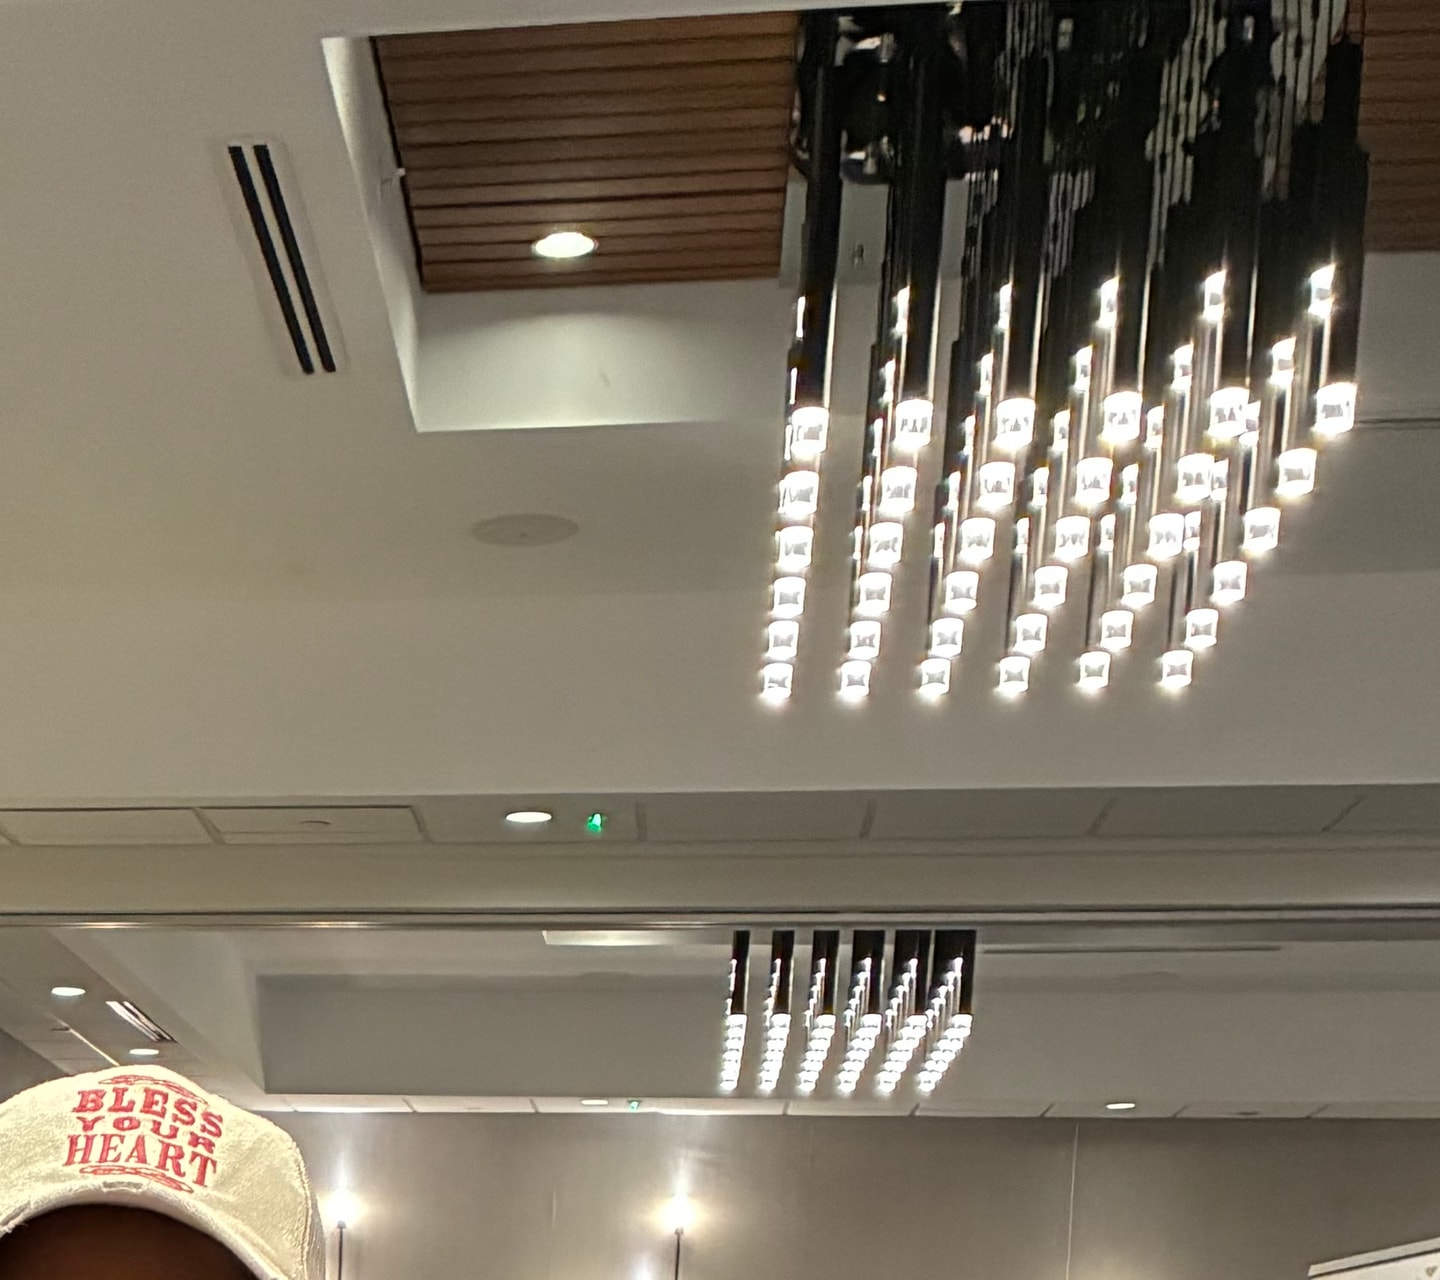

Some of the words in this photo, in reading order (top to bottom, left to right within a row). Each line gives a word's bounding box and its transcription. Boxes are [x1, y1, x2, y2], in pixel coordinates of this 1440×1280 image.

[72, 1086, 225, 1139] BLESS
[77, 1115, 216, 1155] YOUR
[63, 1133, 218, 1188] HEART
